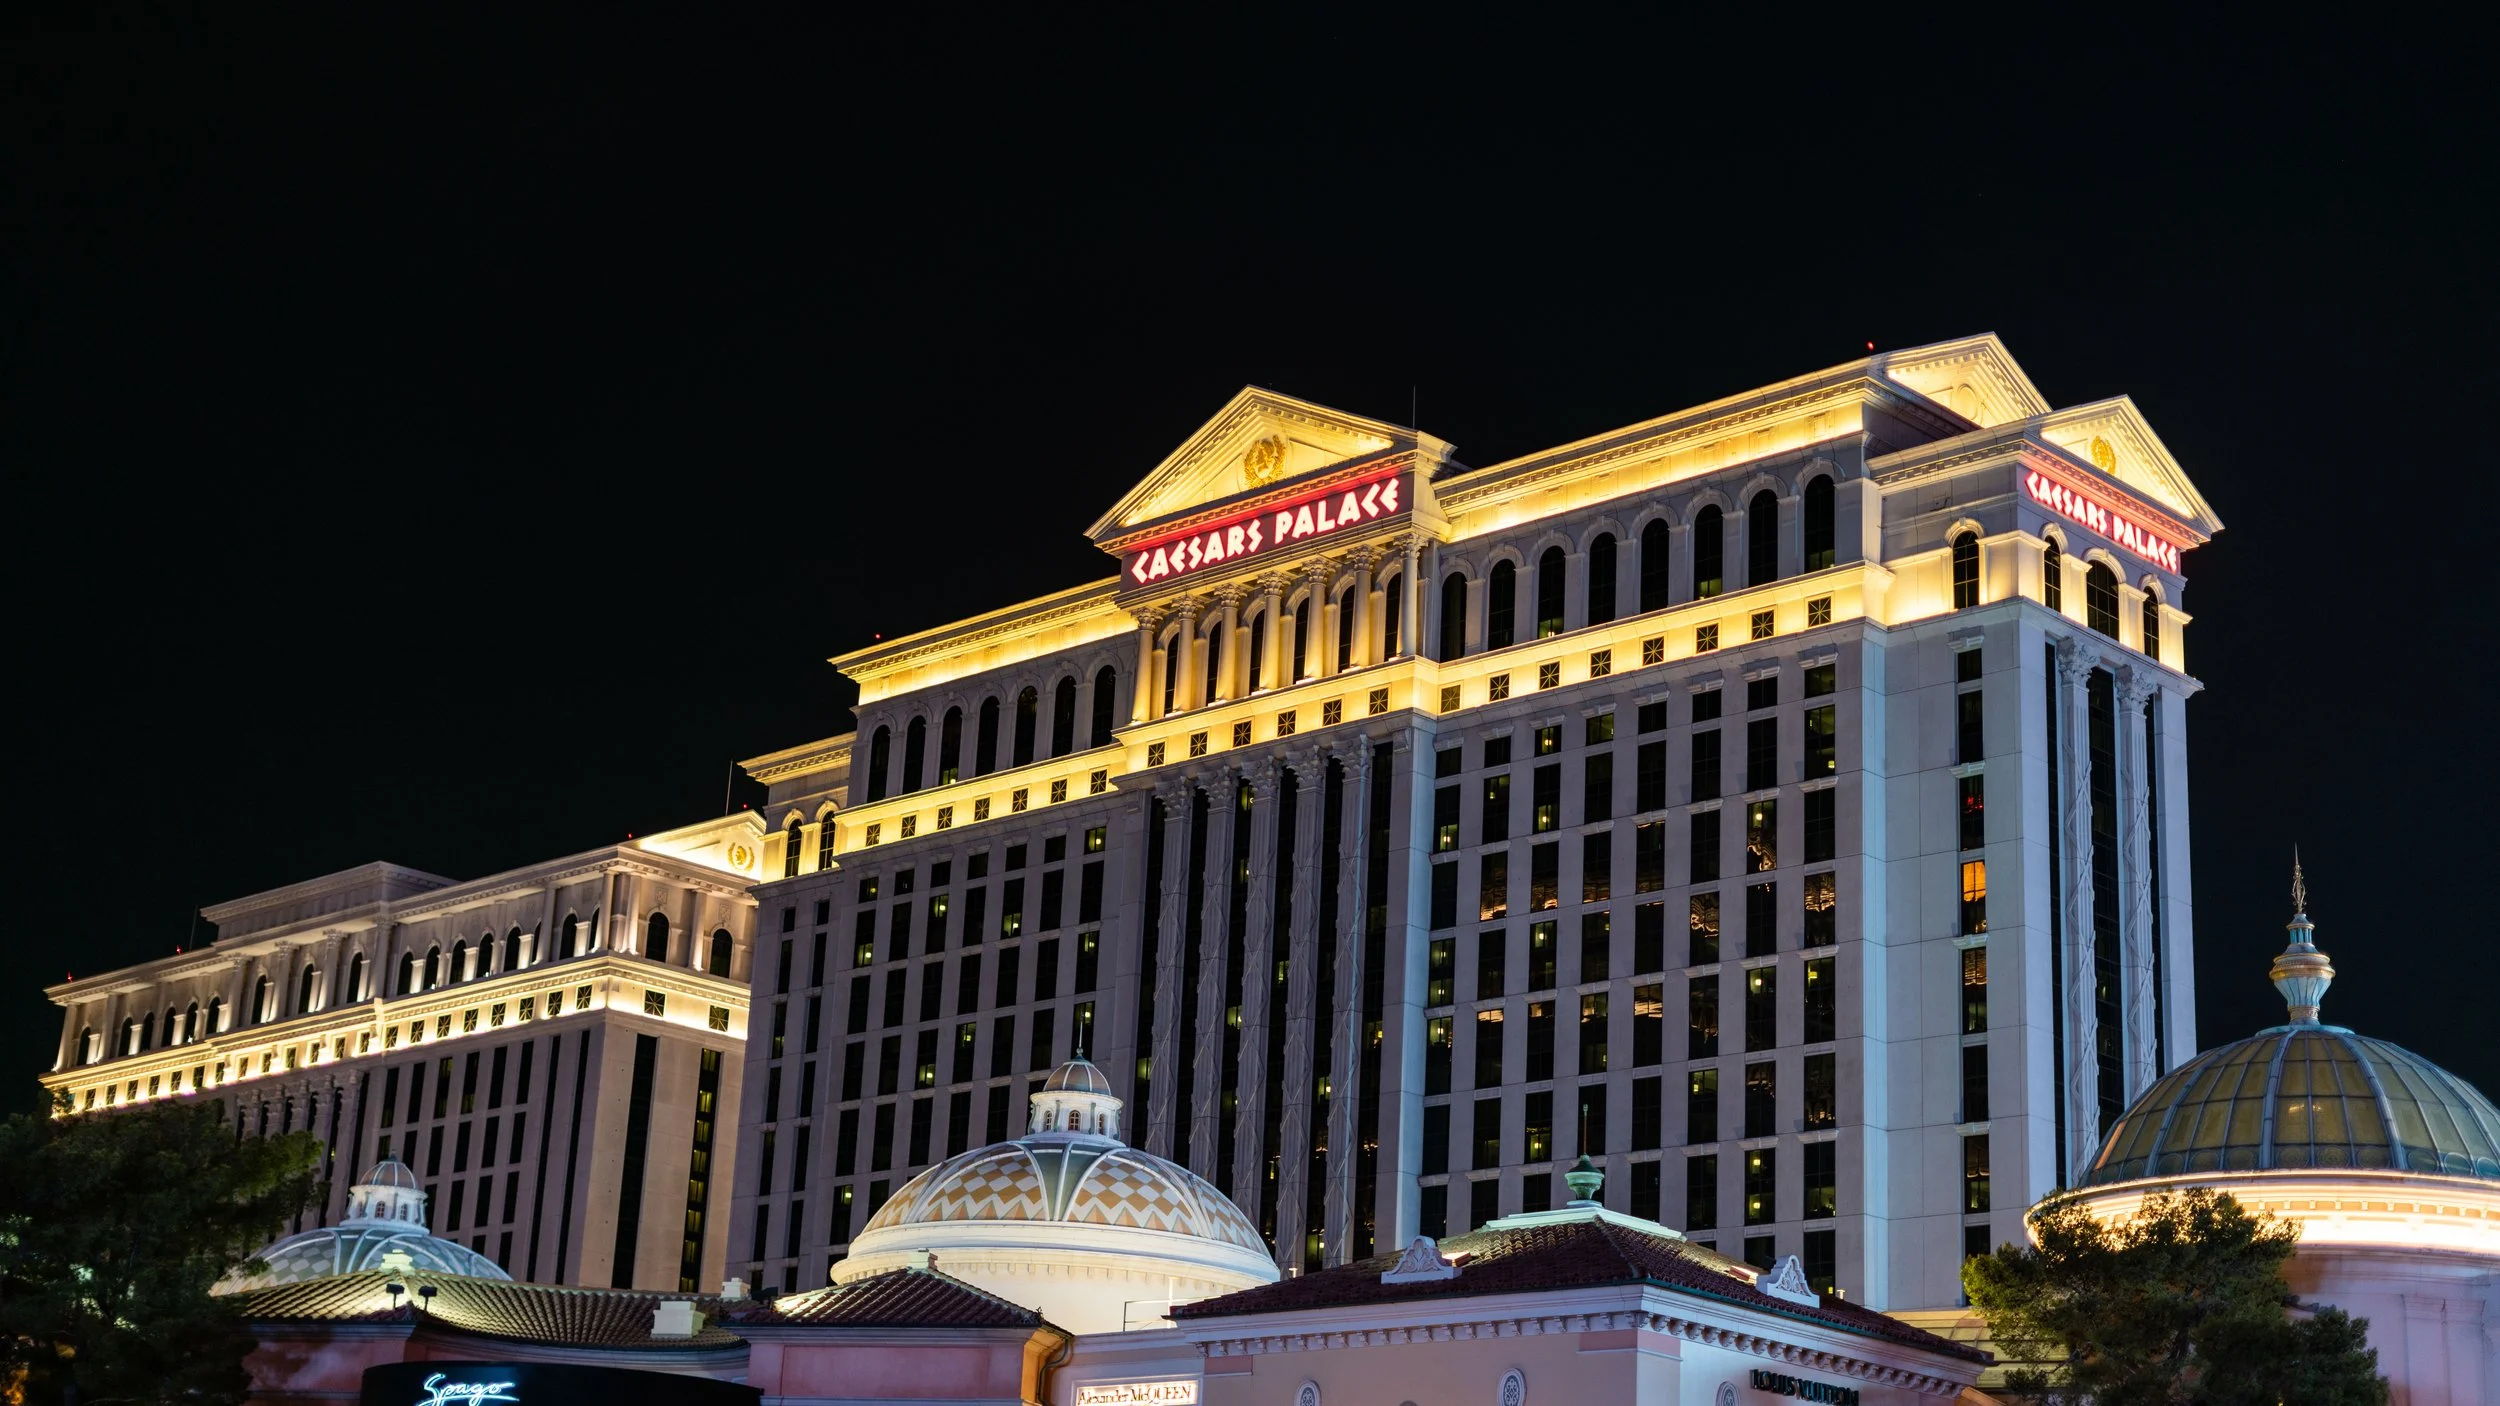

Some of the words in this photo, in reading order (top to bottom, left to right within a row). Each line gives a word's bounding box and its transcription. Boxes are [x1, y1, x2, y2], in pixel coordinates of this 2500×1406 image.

[1131, 519, 1263, 584] CAESARS
[1274, 477, 1400, 545] PALACE
[2025, 471, 2108, 535] CAESARS
[2112, 513, 2178, 574] PALACE
[417, 1373, 520, 1406] Spago
[1077, 1389, 1129, 1406] Alexander
[1749, 1368, 1796, 1397] LOUIS
[1795, 1377, 1860, 1406] VUITTON
